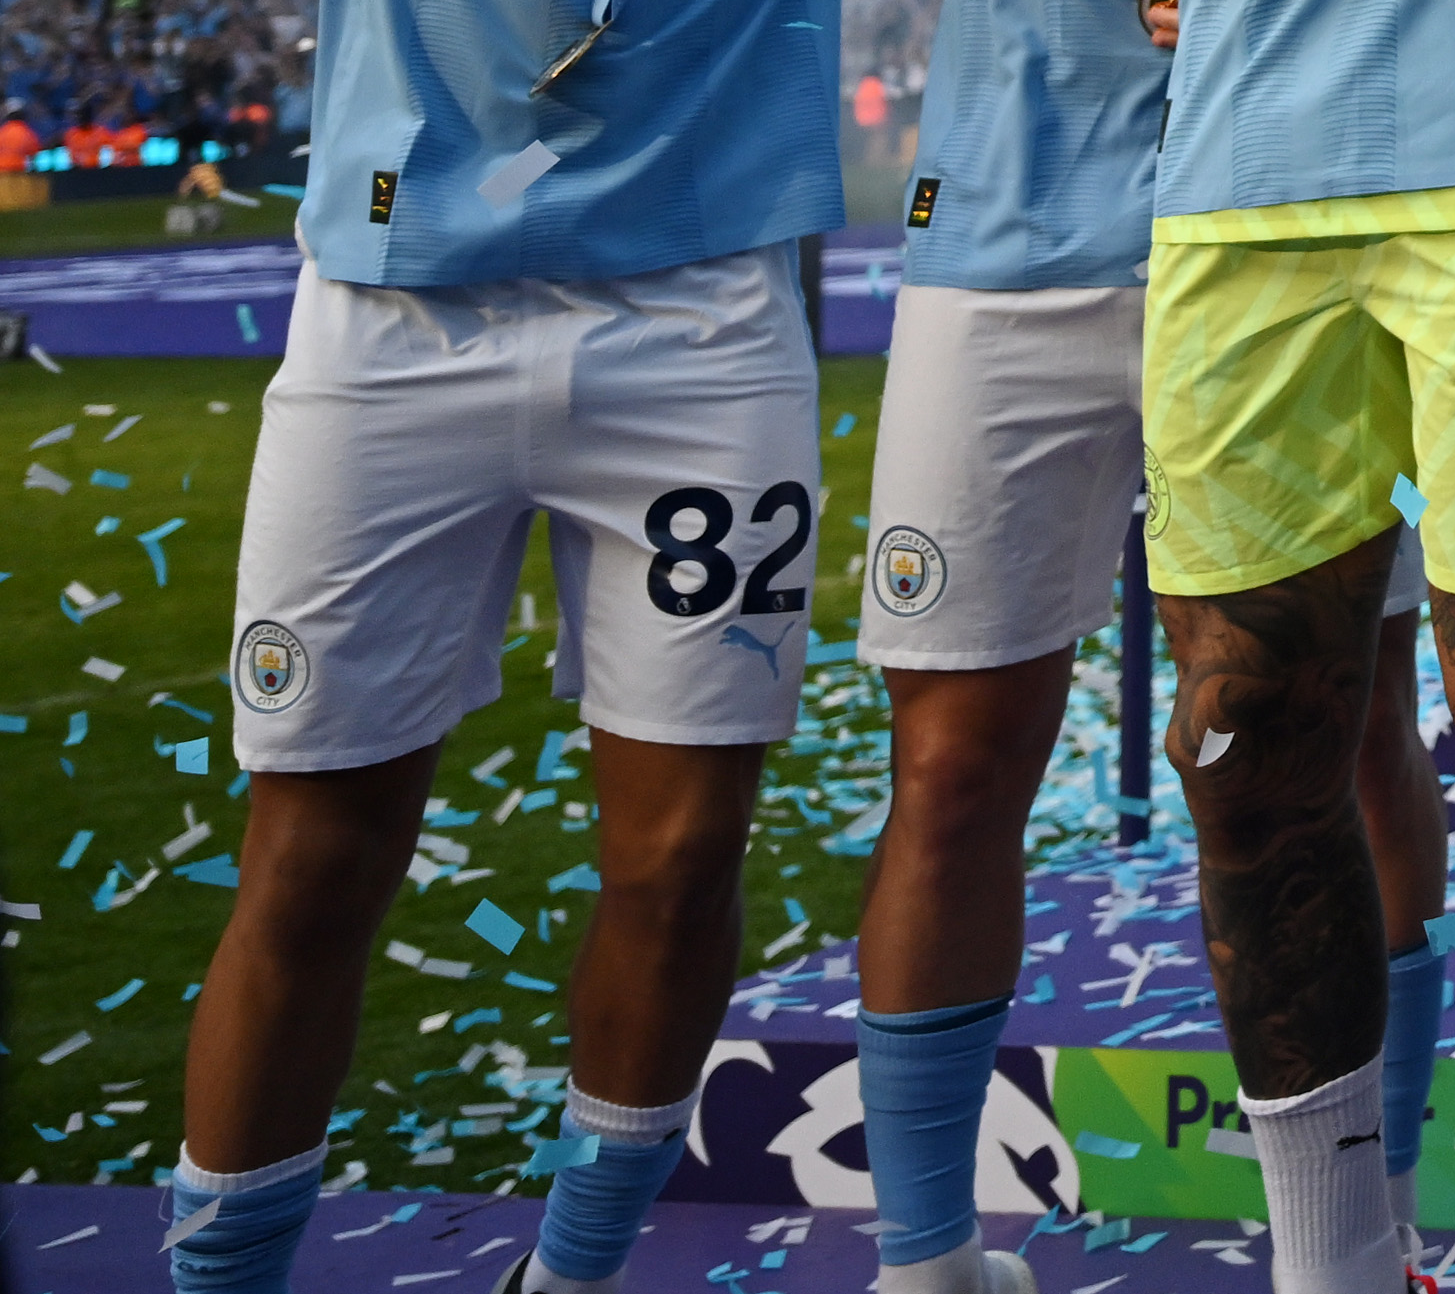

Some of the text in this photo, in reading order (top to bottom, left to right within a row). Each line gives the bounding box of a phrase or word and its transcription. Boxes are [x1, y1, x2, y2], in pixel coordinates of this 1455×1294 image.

[645, 480, 812, 617] 82
[880, 531, 936, 565] MANCHESTER
[893, 599, 917, 610] CITY
[243, 626, 303, 659] MANCHESTER
[256, 694, 281, 707] CITY
